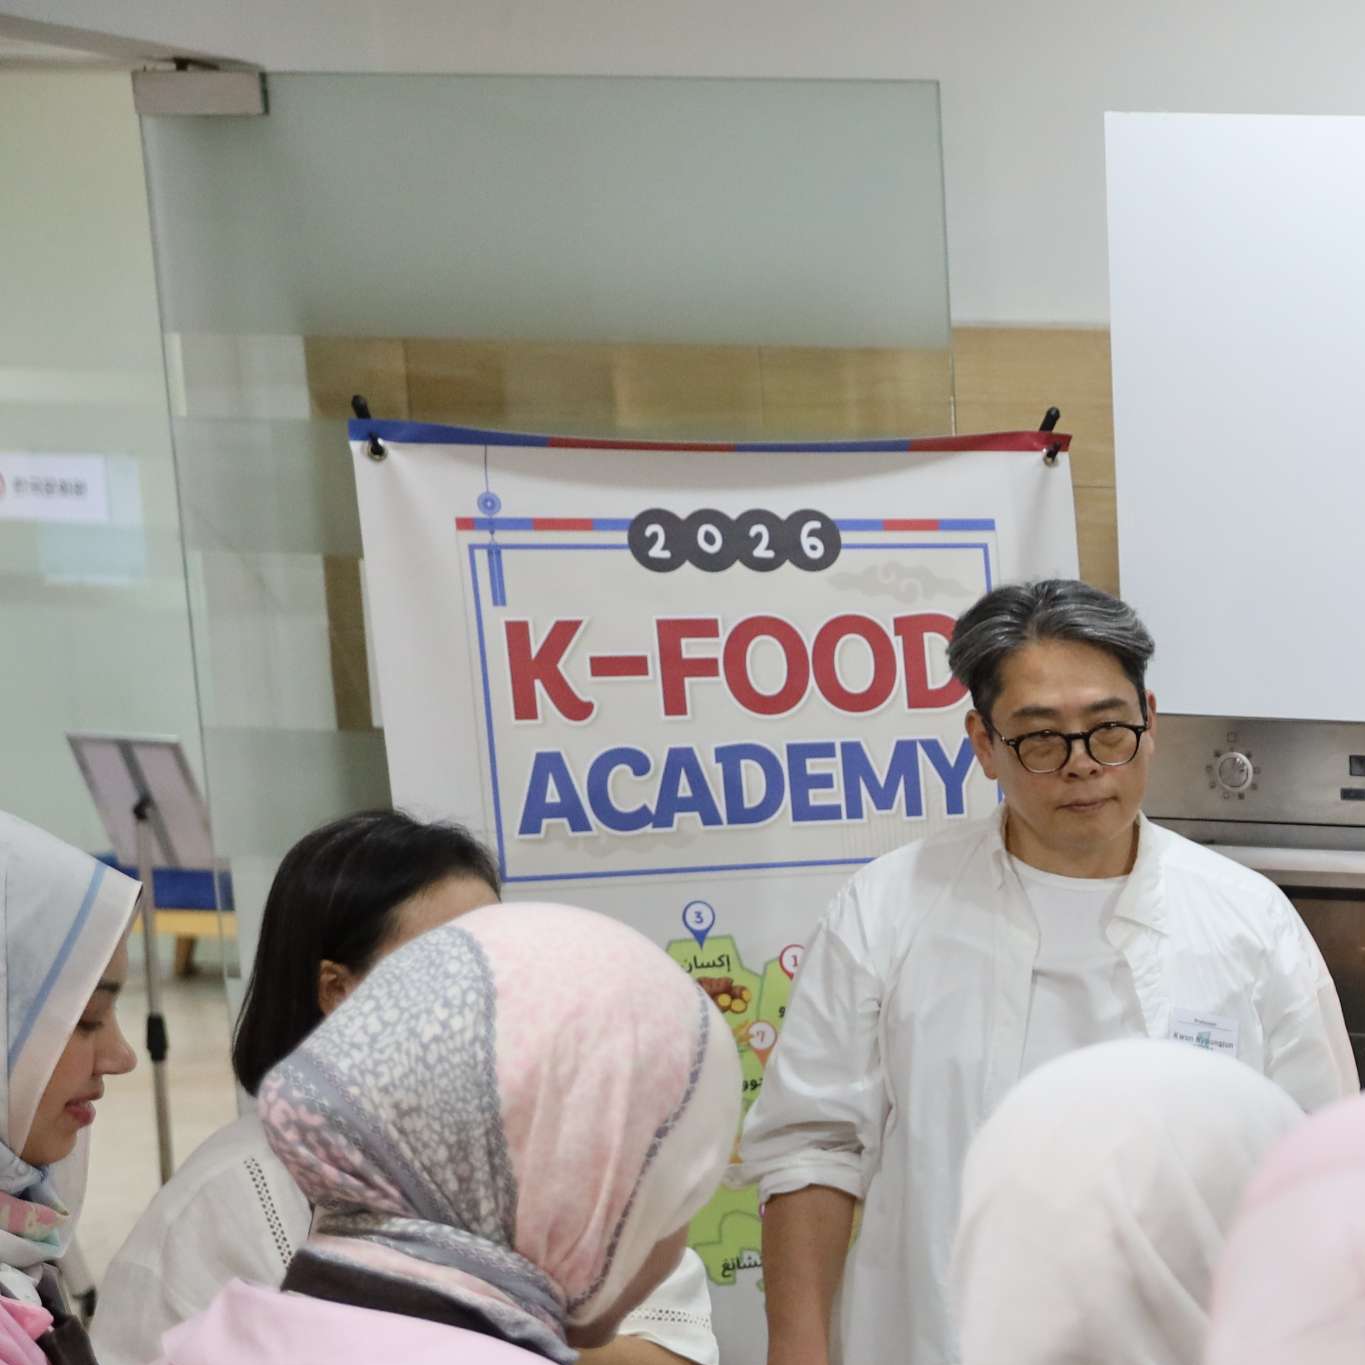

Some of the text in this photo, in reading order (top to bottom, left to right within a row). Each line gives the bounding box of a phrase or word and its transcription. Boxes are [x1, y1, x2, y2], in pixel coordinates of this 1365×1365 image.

[644, 520, 825, 559] 2026
[504, 612, 971, 722] K-FOOD
[517, 736, 976, 835] ACADEMY
[694, 911, 704, 924] 3
